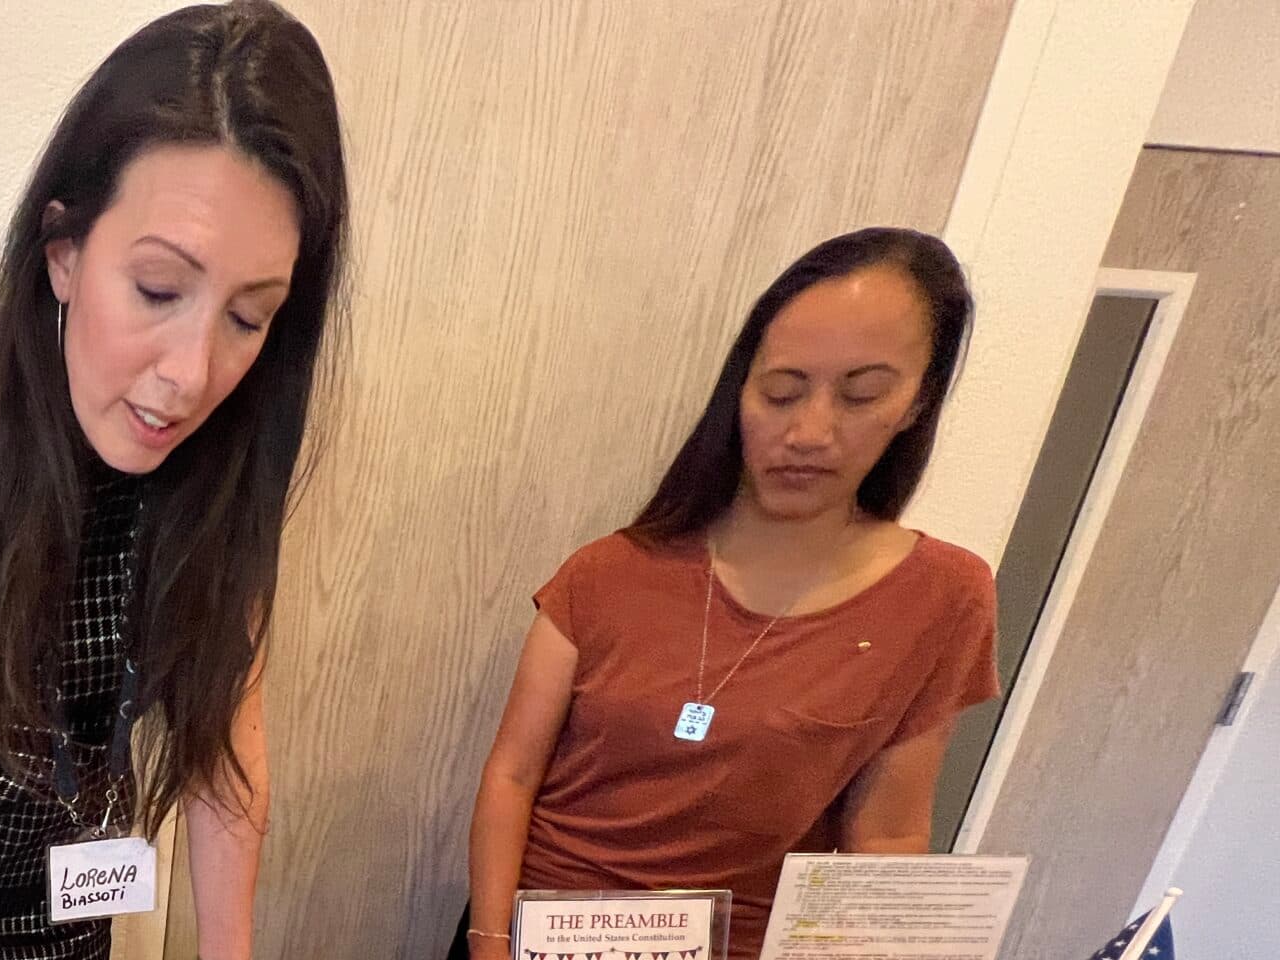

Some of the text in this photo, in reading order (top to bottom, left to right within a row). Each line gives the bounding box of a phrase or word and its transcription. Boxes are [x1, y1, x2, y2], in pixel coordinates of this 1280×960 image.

[546, 913, 688, 930] THE PREAMBLE
[557, 934, 570, 942] the
[573, 934, 602, 942] United
[605, 934, 629, 942] States
[632, 933, 685, 942] Constitution
